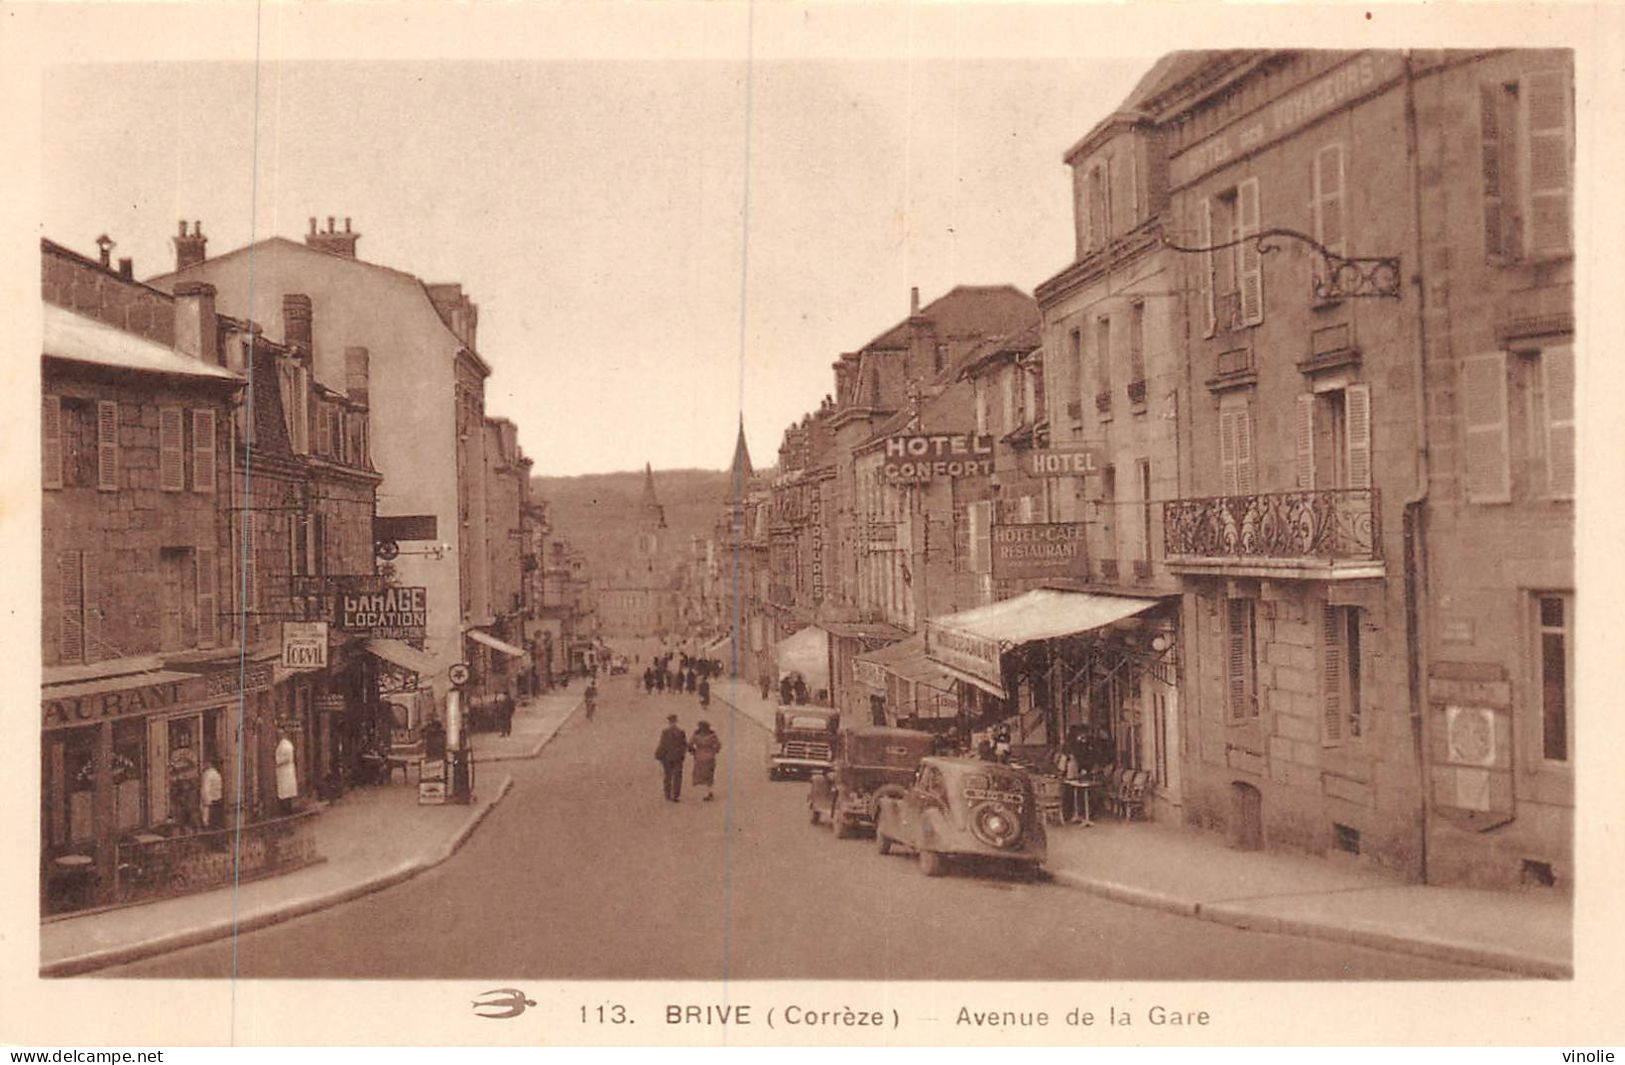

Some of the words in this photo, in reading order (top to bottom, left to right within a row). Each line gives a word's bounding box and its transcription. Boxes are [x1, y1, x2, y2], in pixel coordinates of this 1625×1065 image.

[886, 436, 992, 457] HOTEL
[884, 460, 992, 478] CONFORT
[1033, 453, 1097, 473] HOTEL
[1000, 543, 1078, 559] RESTAURANT
[344, 588, 425, 612] GARAGE
[344, 612, 425, 627] LOCATION
